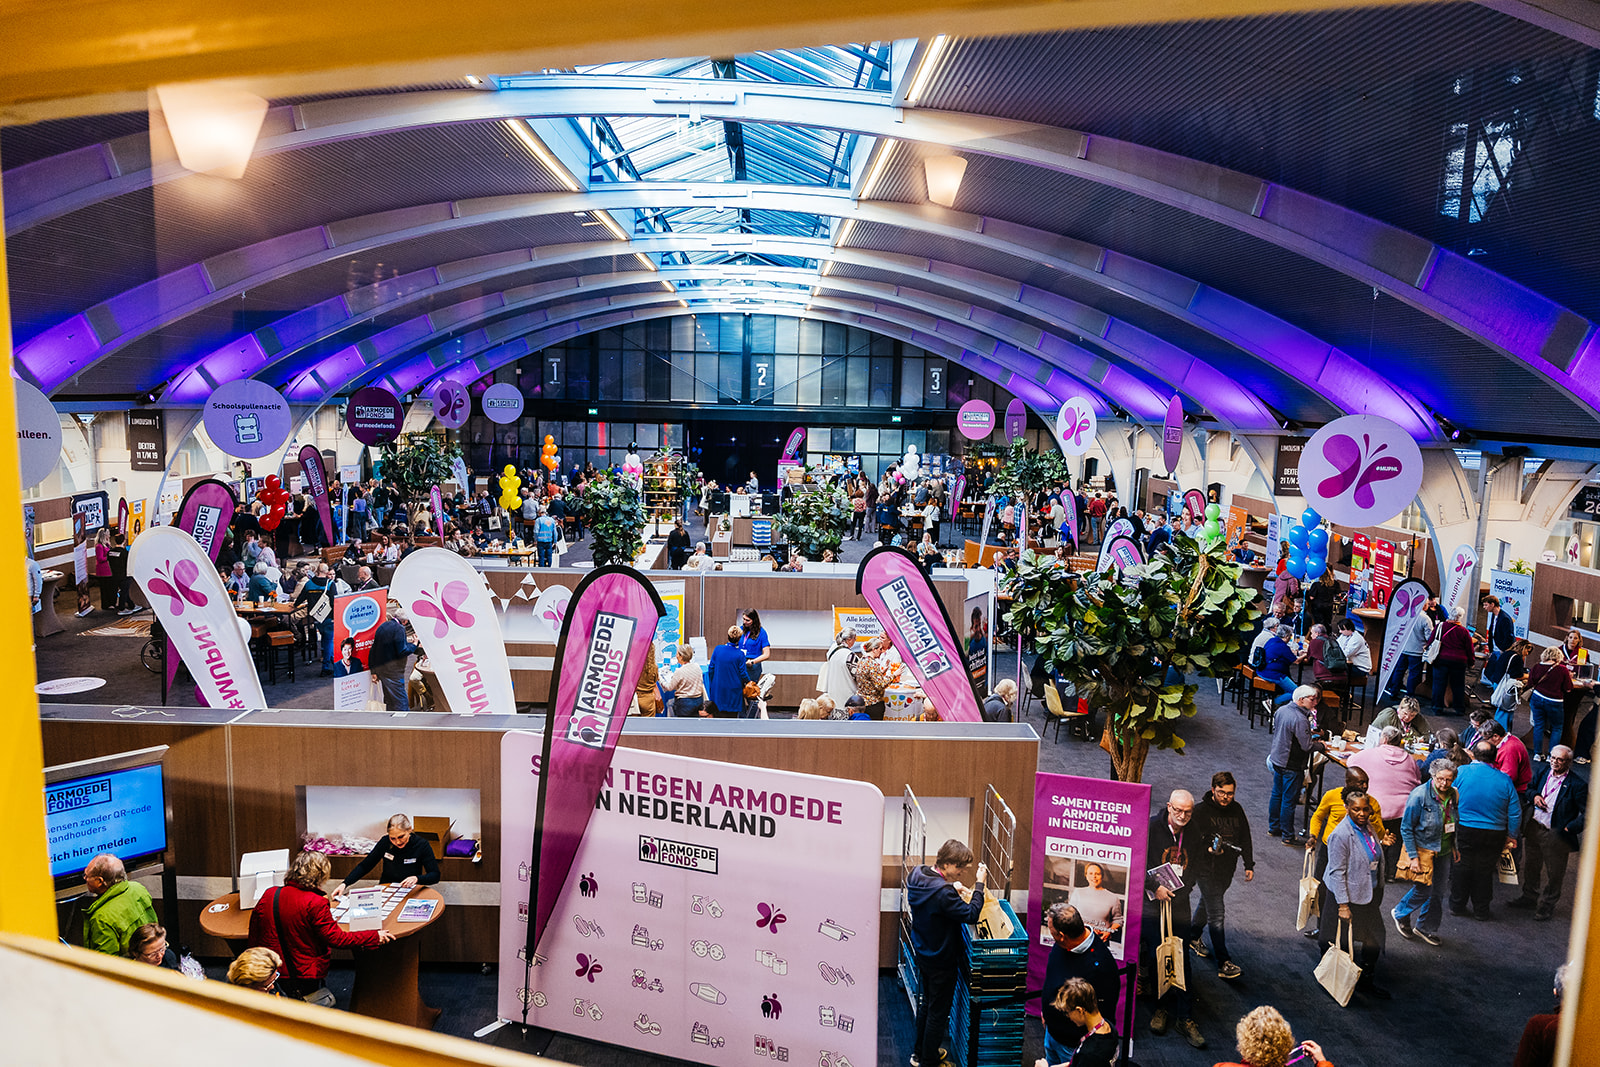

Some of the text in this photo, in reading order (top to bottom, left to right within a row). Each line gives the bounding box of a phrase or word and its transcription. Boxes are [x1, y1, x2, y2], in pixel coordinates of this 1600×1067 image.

[551, 362, 558, 381] 1
[757, 367, 767, 386] 2
[931, 372, 940, 390] 3
[212, 402, 282, 411] Schoolspullenactie
[16, 430, 52, 440] alleen.
[1283, 468, 1298, 476] DEXTE
[194, 505, 211, 543] MOEDE
[1494, 583, 1525, 595] handprint
[1495, 578, 1513, 586] social
[581, 615, 616, 710] ARMOEDE
[596, 649, 624, 713] FONDS
[48, 782, 108, 803] ARMOEDE
[620, 768, 703, 803] TEGEN
[709, 783, 842, 825] ARMOEDE
[48, 795, 90, 812] FONDS
[1051, 795, 1132, 815] SAMEN TEGEN
[47, 804, 152, 835] ensen zonder QR-code
[619, 792, 776, 838] NEDERLAND
[1062, 808, 1119, 825] ARMOEDE
[1210, 816, 1240, 828] NORTH
[48, 825, 107, 845] tandhouders
[1048, 816, 1132, 837] IN NEDERLAND
[72, 846, 95, 858] hier
[97, 836, 137, 852] melden
[661, 841, 716, 862] ARMOEDE
[1050, 842, 1127, 862] arm in arm
[661, 851, 698, 868] FONDS
